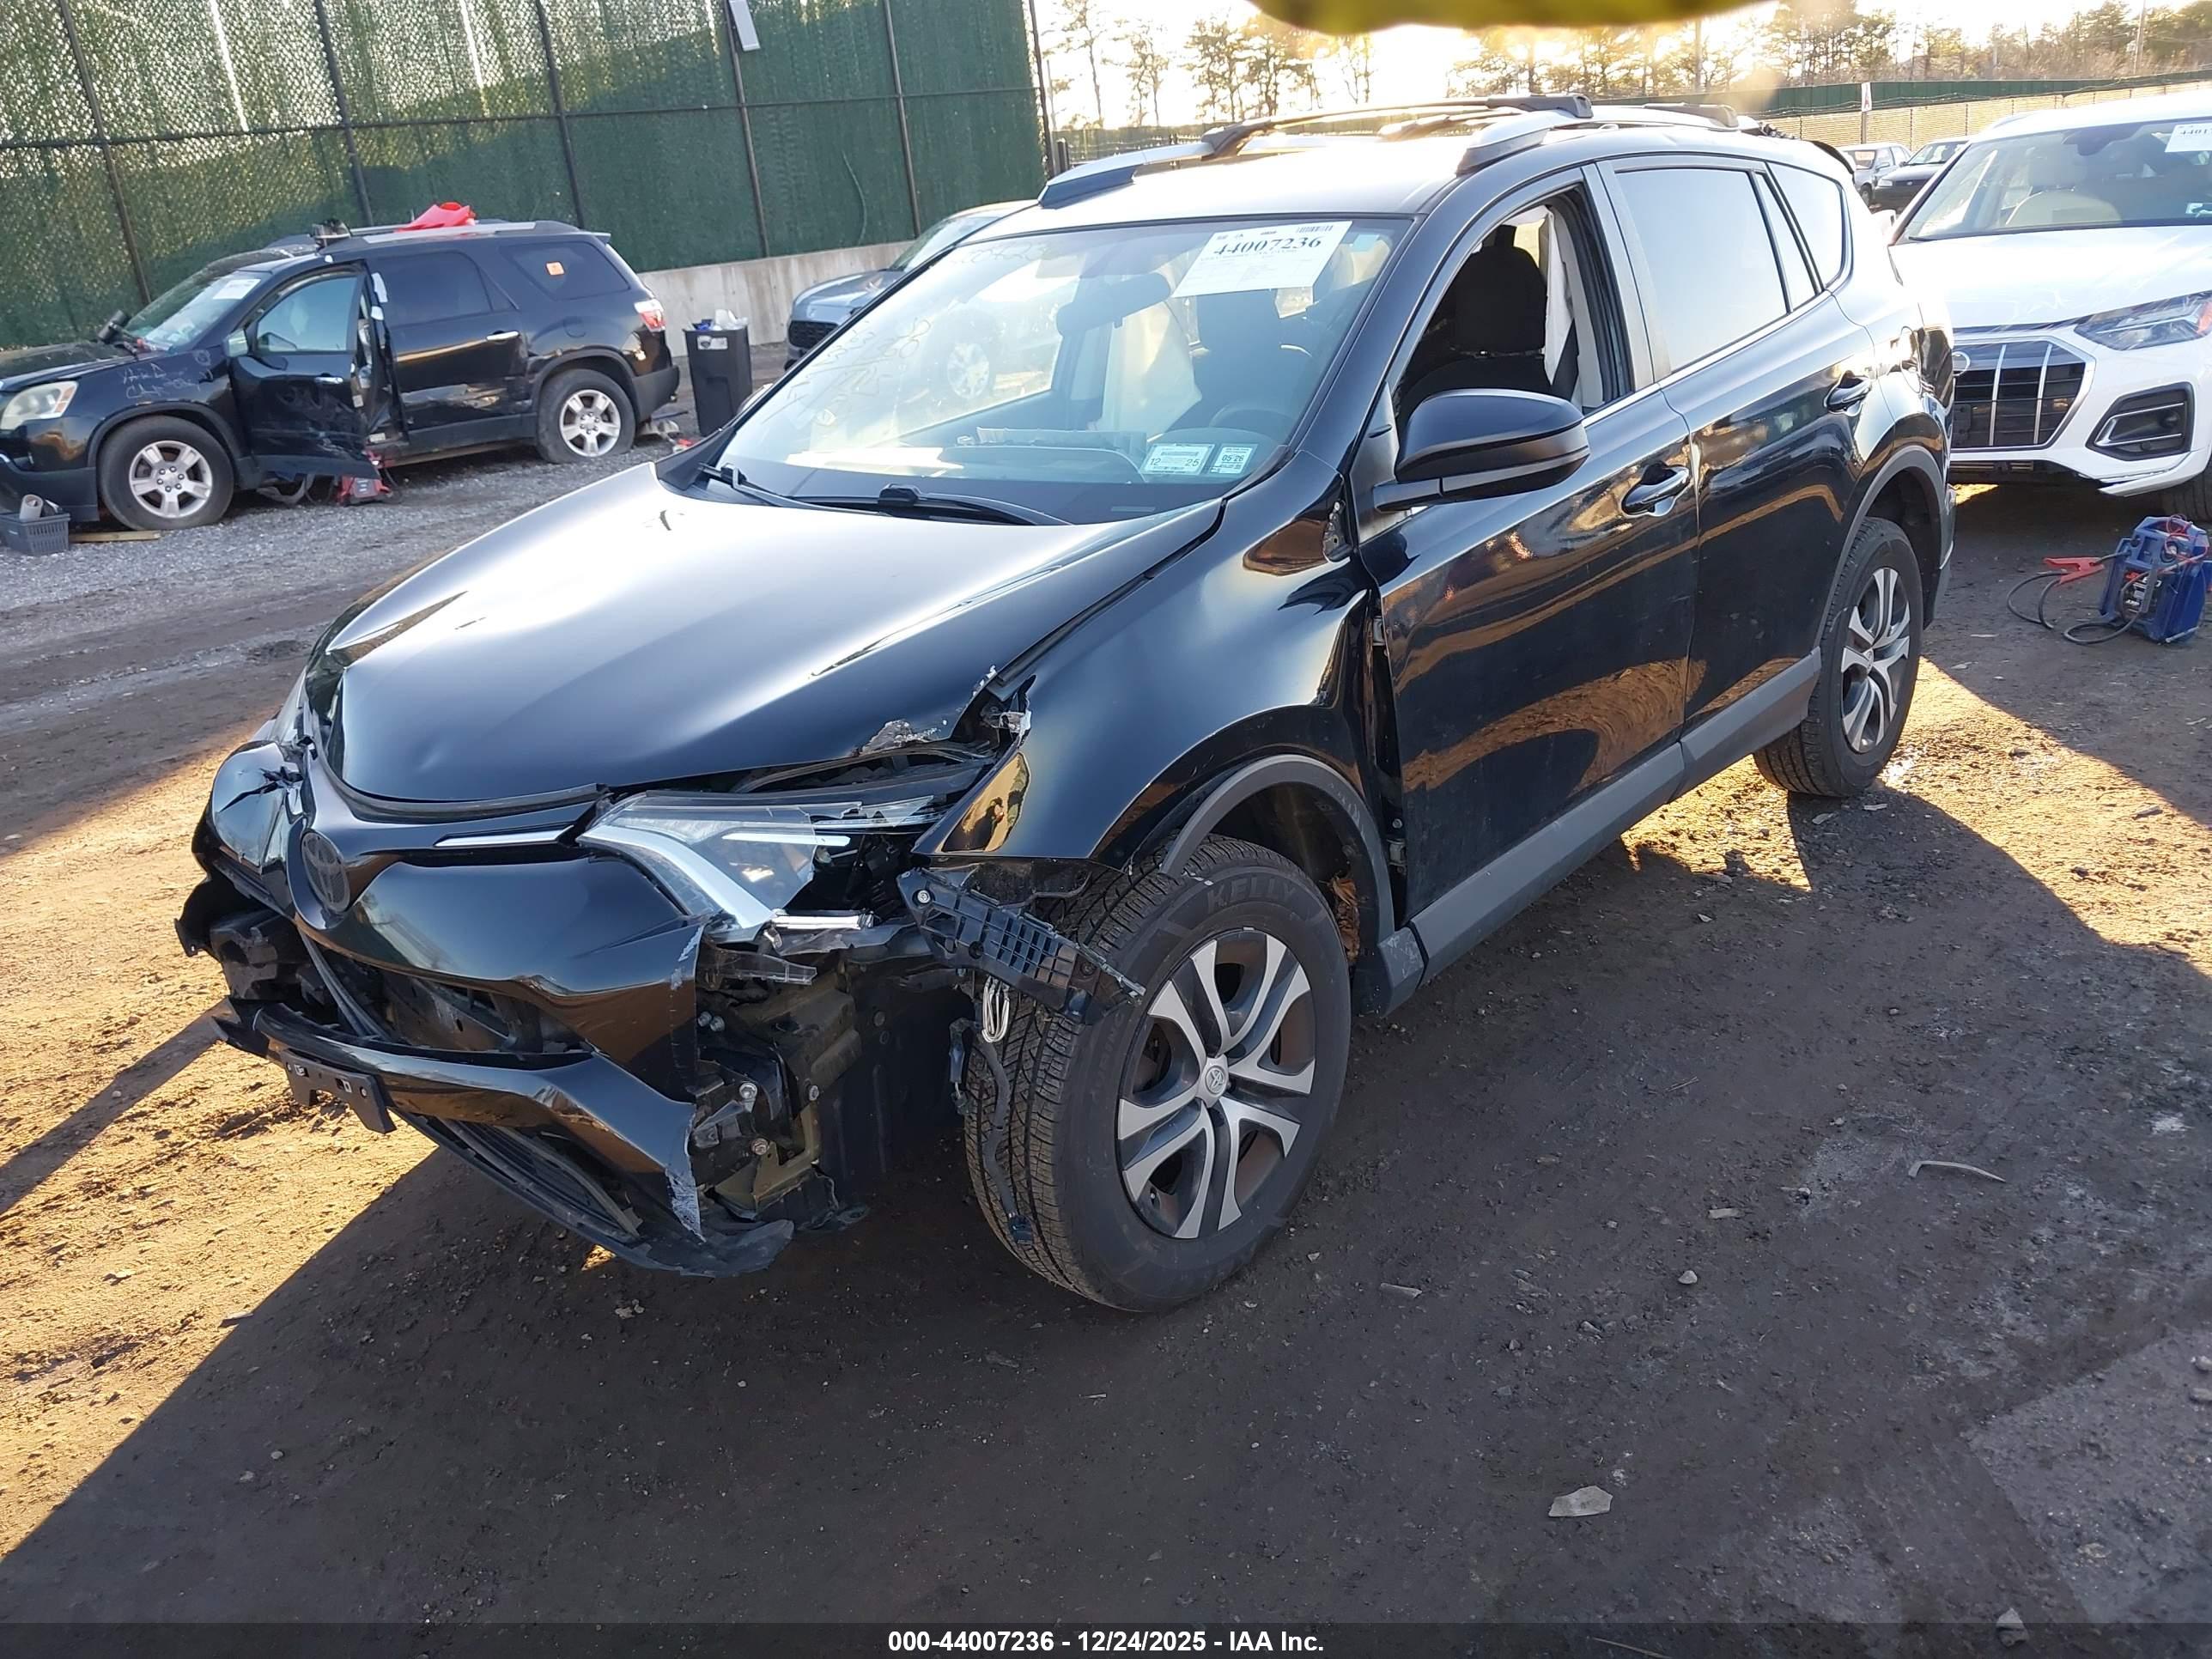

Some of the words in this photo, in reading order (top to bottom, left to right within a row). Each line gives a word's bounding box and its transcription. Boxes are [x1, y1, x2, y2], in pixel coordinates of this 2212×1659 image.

[1213, 236, 1322, 255] 44007236
[1150, 458, 1161, 466] 12
[1185, 459, 1200, 467] 25
[1206, 877, 1296, 915] KELLY
